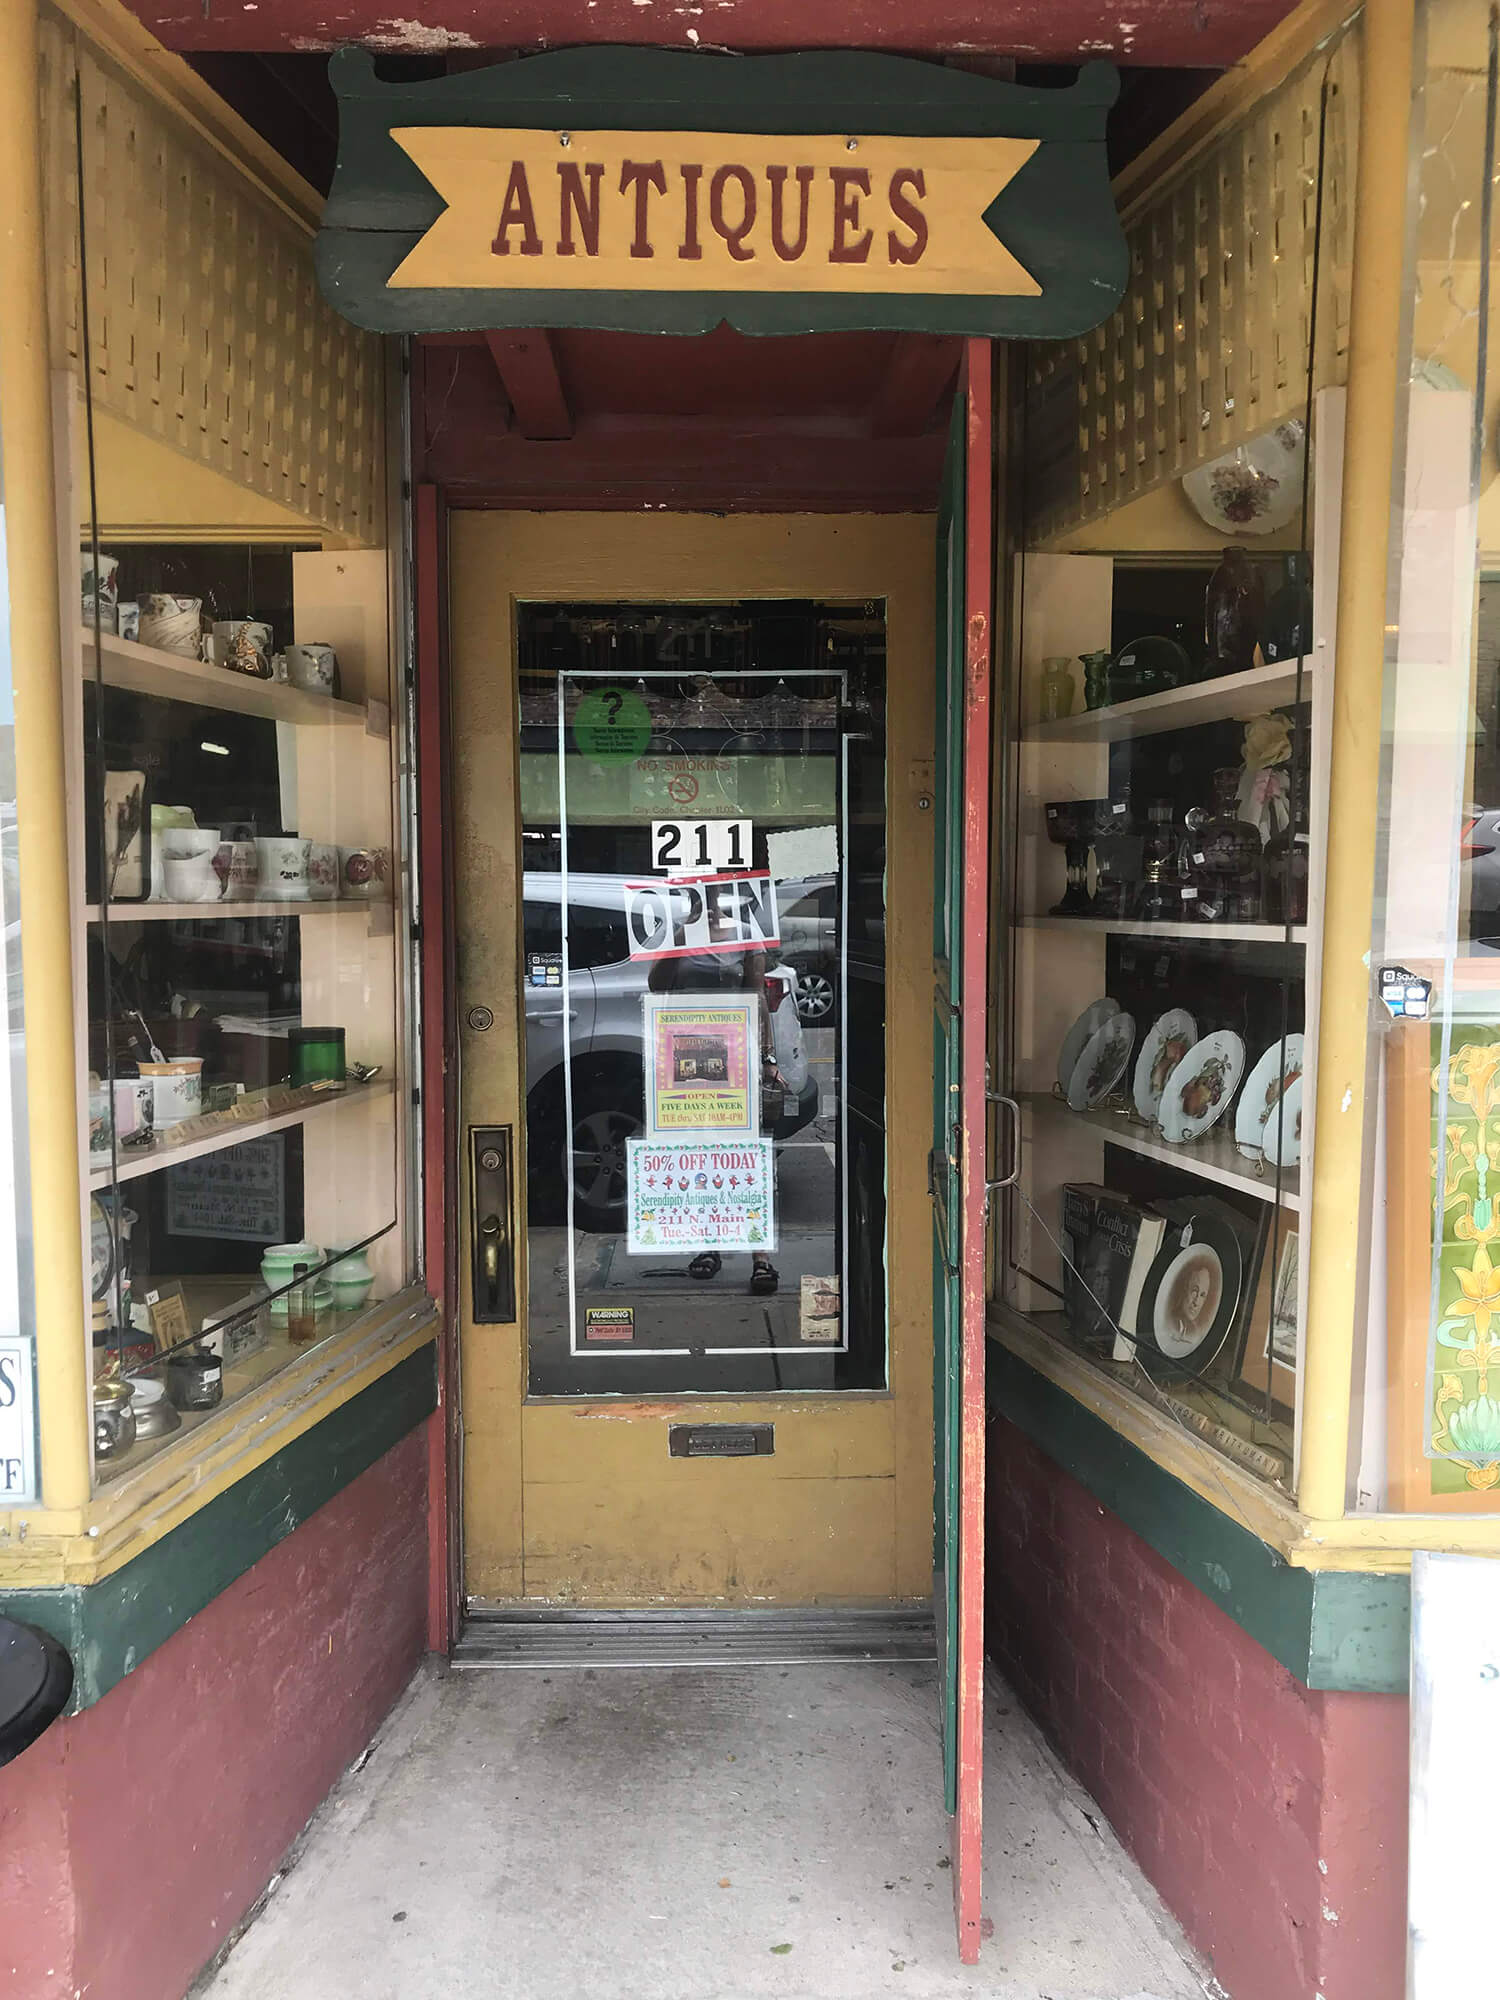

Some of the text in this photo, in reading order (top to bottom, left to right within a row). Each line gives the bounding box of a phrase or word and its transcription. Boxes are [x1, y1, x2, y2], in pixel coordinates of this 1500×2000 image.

[490, 159, 929, 266] ANTIQUES
[637, 759, 731, 771] NO SMOKING
[657, 824, 744, 865] 211
[631, 879, 775, 949] OPEN
[661, 1013, 743, 1023] SERENDIPITY ANTIQUES
[661, 1103, 682, 1111] FIVE
[708, 1102, 715, 1110] A
[717, 1102, 743, 1110] WEEK
[662, 1114, 675, 1122] TUE
[643, 1152, 758, 1172] 50% OFF TODAY
[640, 1190, 762, 1208] Serendipity Antiques & Nostalgia
[658, 1214, 745, 1225] 211 N. Main
[660, 1224, 741, 1238] Tue.-Sat. 10-4
[591, 1311, 629, 1319] WARNING
